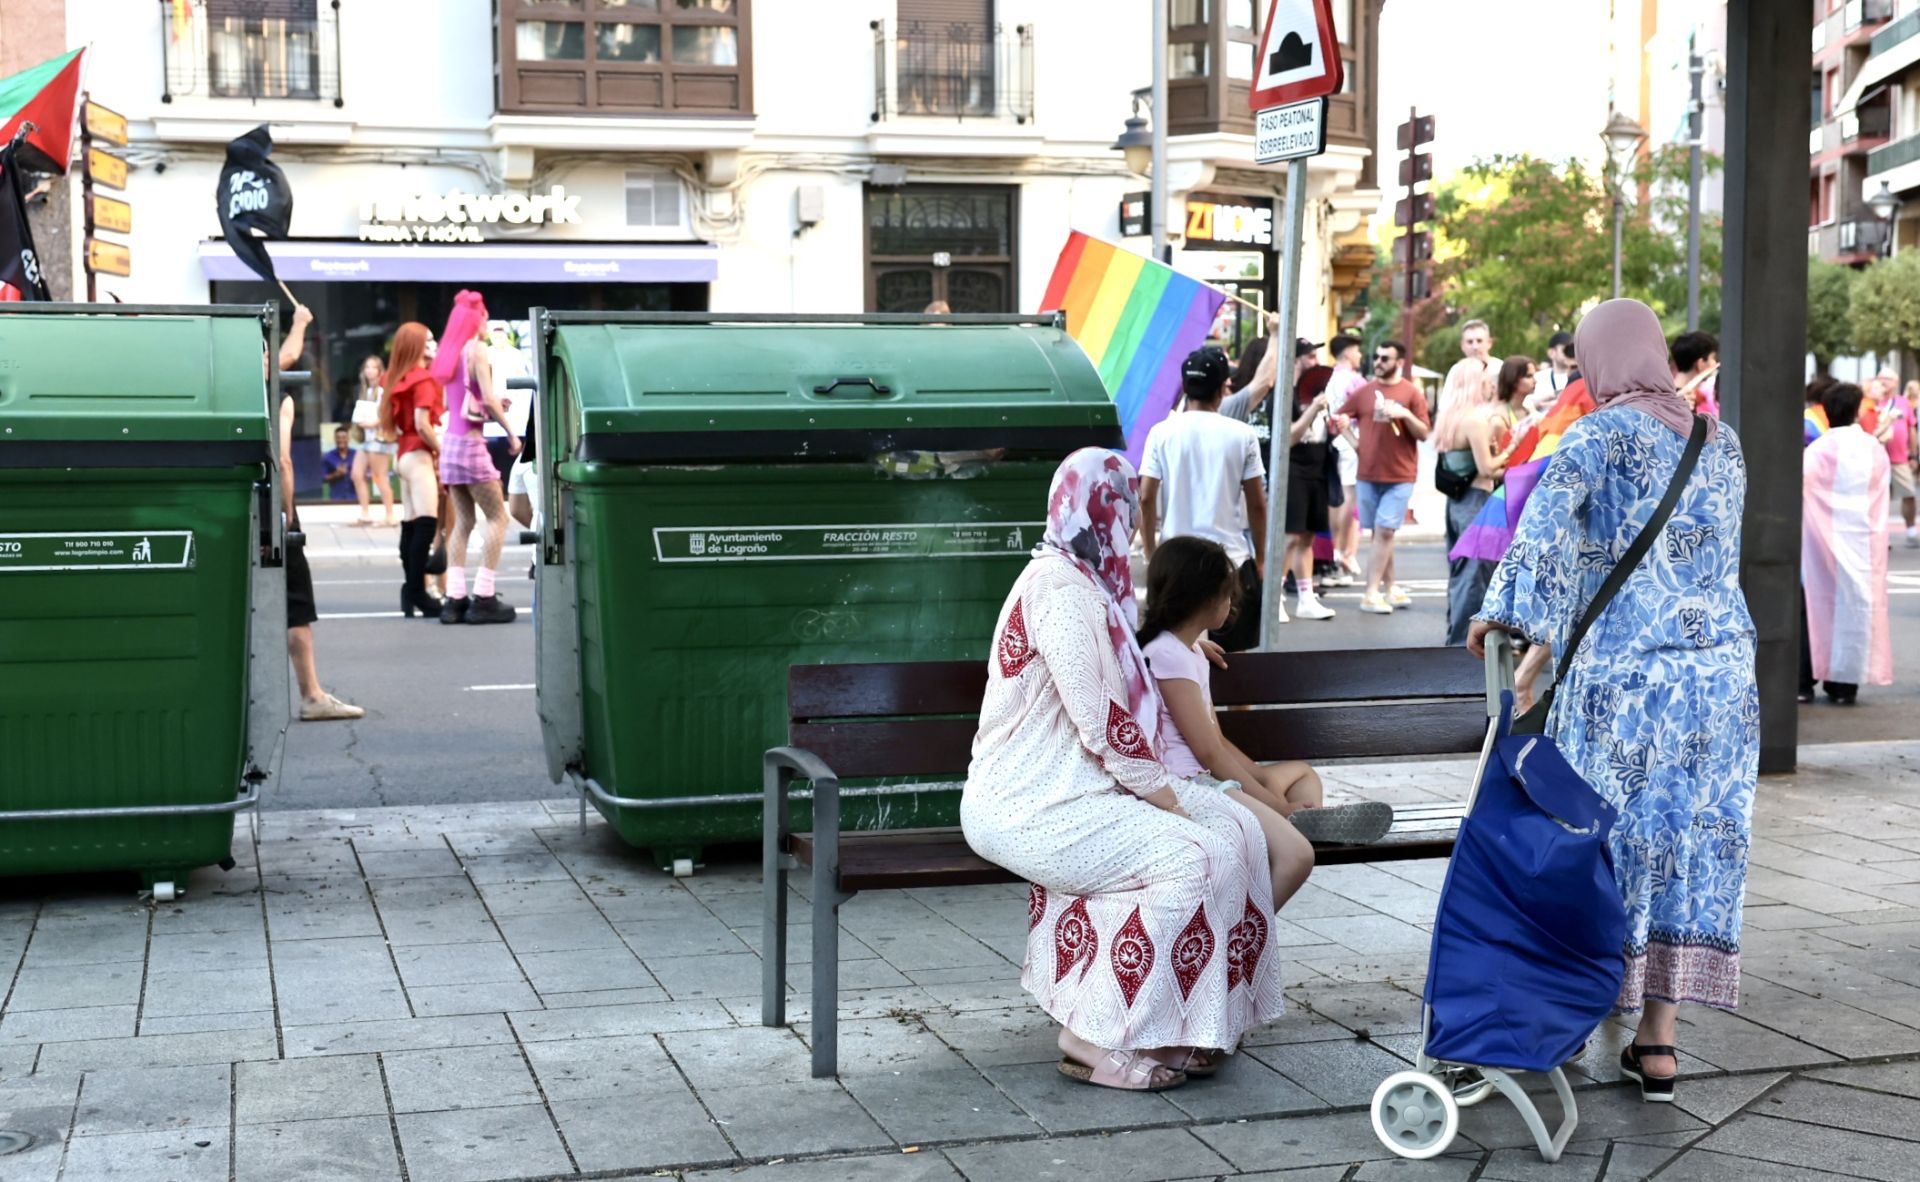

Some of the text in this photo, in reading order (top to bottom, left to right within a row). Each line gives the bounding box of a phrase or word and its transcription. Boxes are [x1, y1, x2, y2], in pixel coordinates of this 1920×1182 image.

[1260, 106, 1314, 132] PASO PEATONAL
[1259, 130, 1314, 155] SOBREELEVADO
[412, 225, 427, 242] Y
[707, 532, 783, 543] Ayuntamiento
[823, 529, 918, 542] FRACCIÓN RESTO
[707, 543, 768, 555] de Logroño
